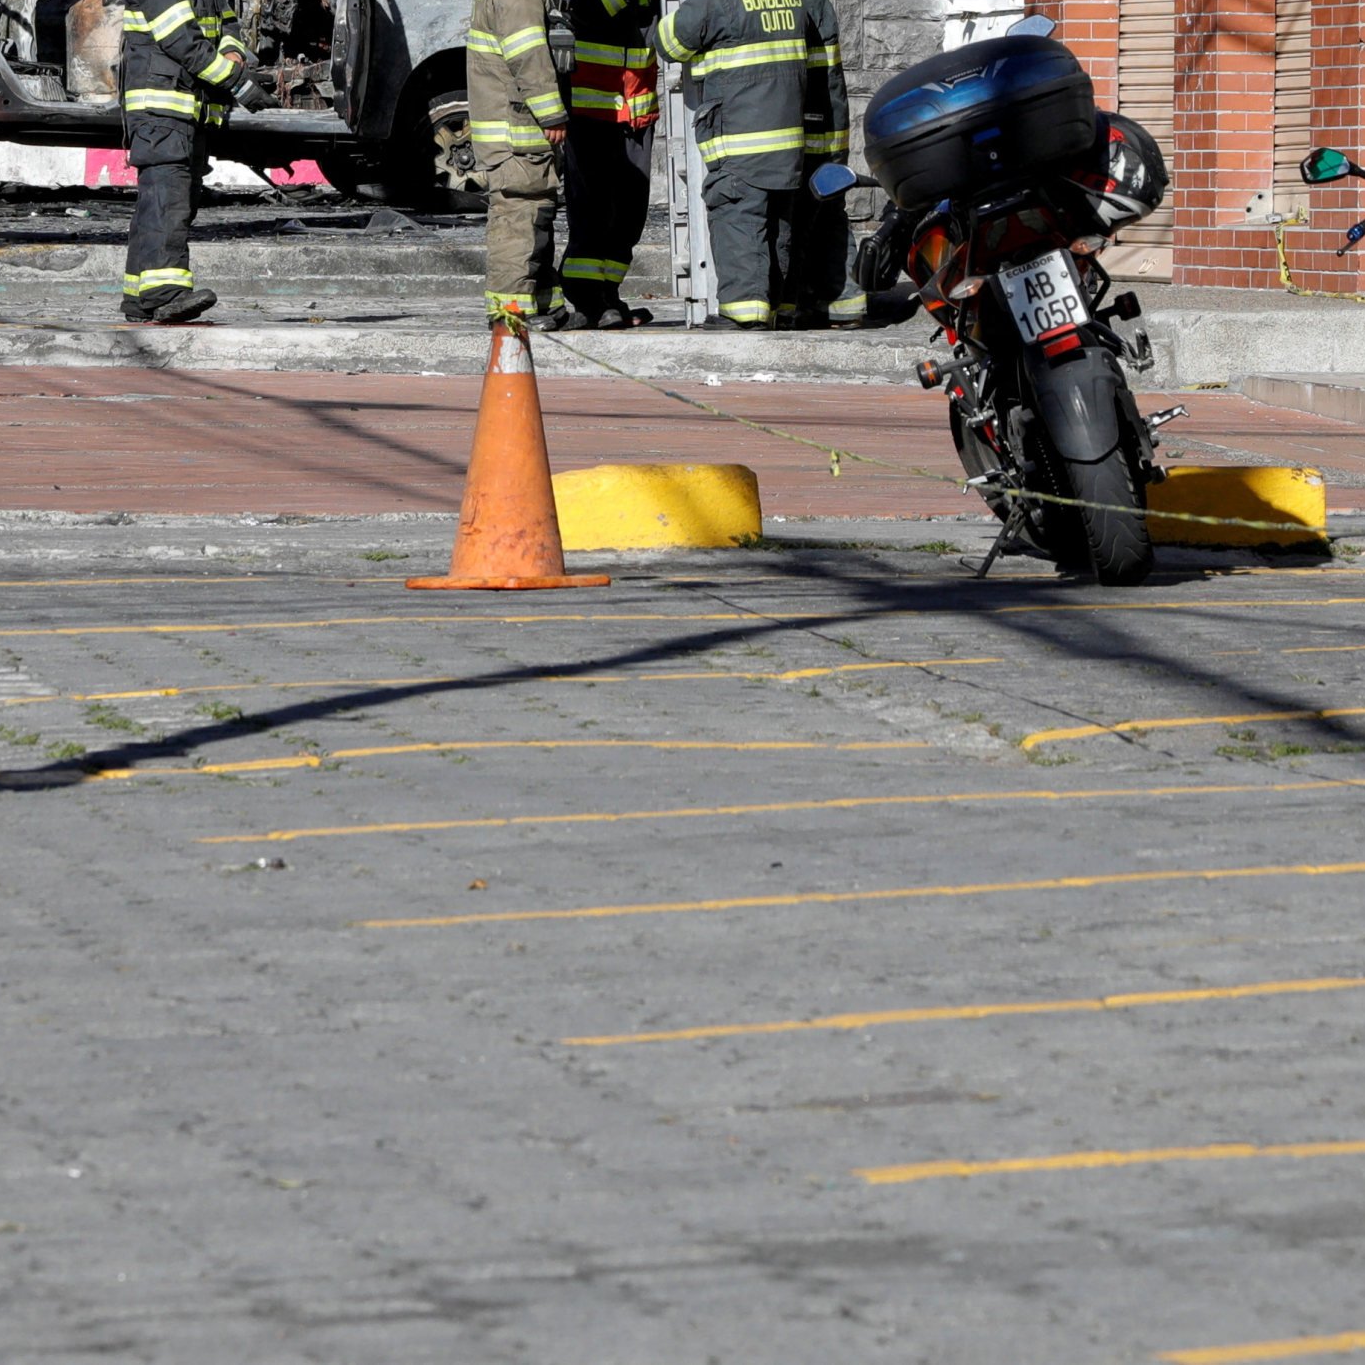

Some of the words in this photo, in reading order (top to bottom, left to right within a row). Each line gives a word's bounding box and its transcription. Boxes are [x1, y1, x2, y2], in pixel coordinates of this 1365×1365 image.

[761, 9, 795, 33] QUITO
[1006, 254, 1055, 278] ECUADOR
[1024, 270, 1055, 304] AB
[1019, 294, 1078, 337] 105P
